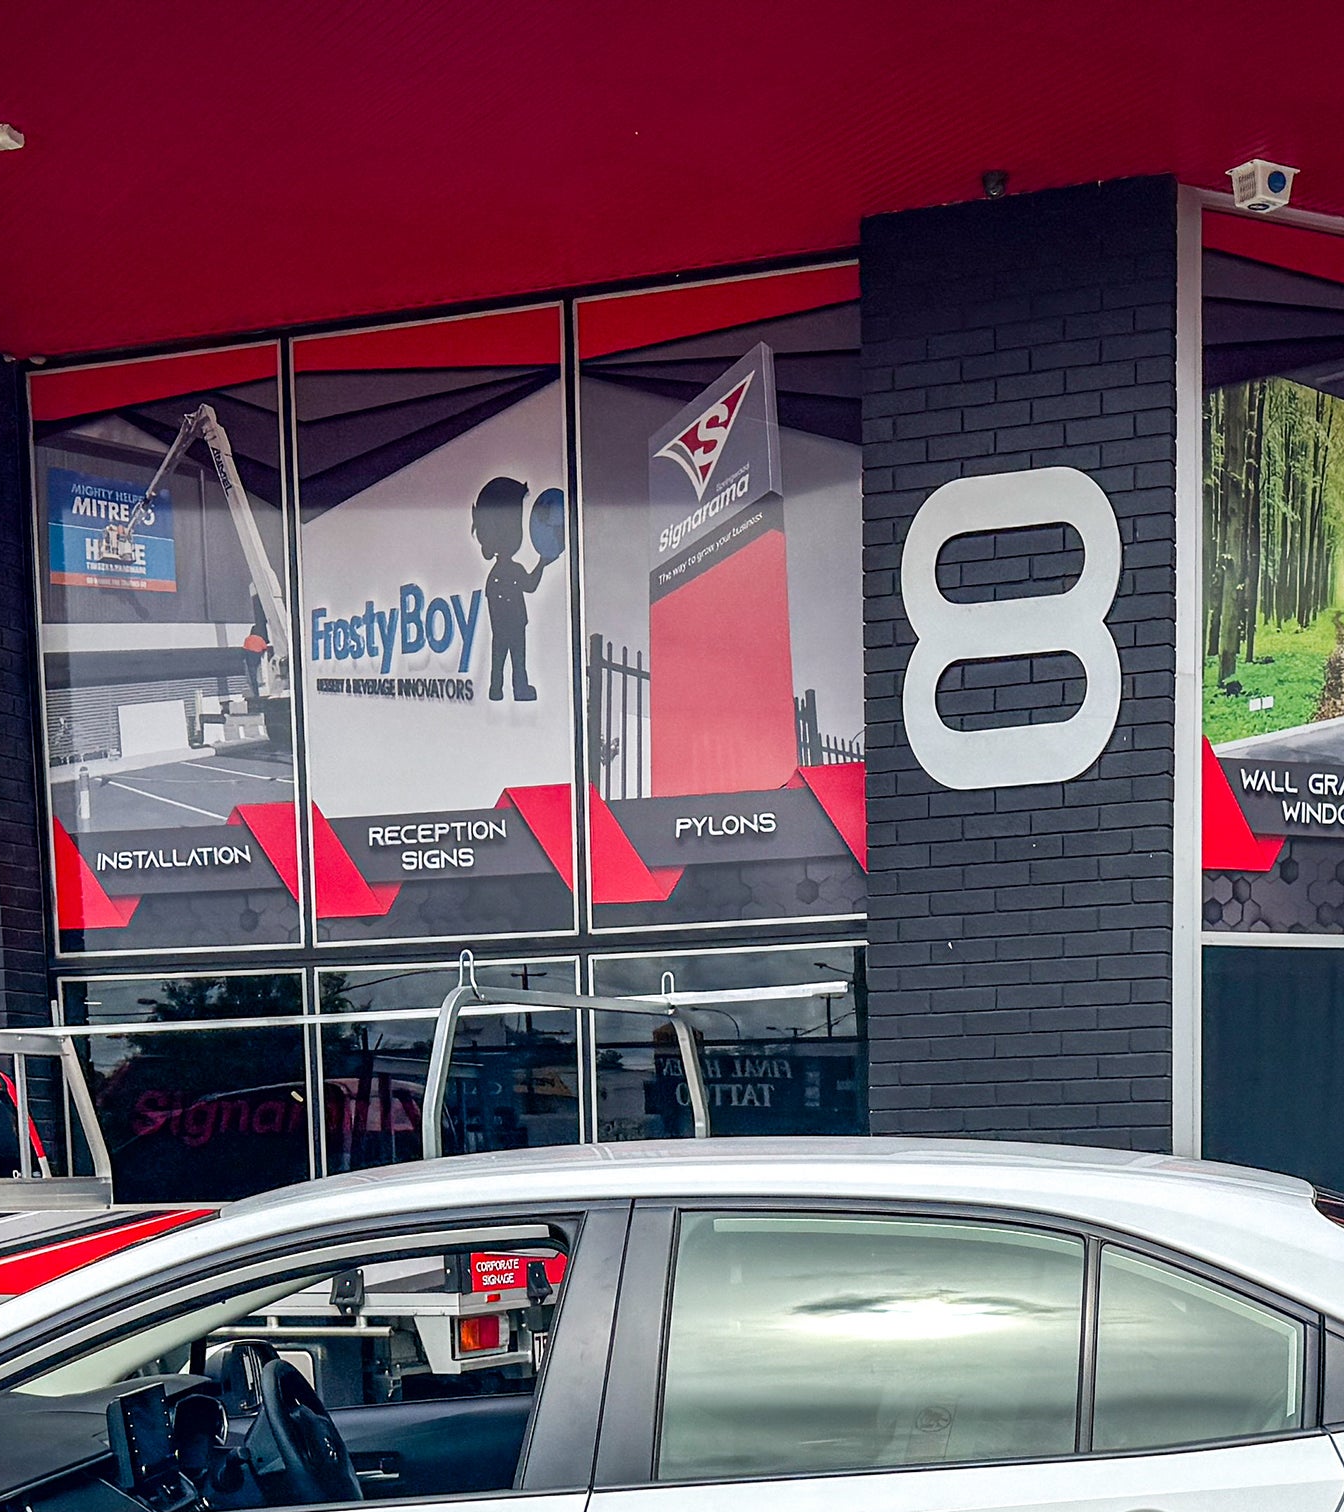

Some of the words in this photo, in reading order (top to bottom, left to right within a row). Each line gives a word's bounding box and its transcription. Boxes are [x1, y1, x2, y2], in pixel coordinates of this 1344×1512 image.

[71, 483, 113, 500] MIGHTY
[72, 496, 129, 522] MITRE
[659, 473, 750, 552] Signarama
[659, 571, 672, 585] The
[672, 561, 687, 573] way
[688, 555, 696, 566] to
[715, 531, 731, 551] your
[901, 466, 1122, 790] 8
[397, 678, 474, 700] INNOVATORS
[1240, 768, 1298, 794] WALL
[368, 820, 506, 846] RECEPTION
[675, 812, 777, 838] PYLONS
[96, 844, 252, 871] INSTALLATION
[402, 848, 474, 871] SIGNS
[475, 1258, 520, 1273] CORPORATE
[482, 1273, 515, 1286] SIGNAGE
